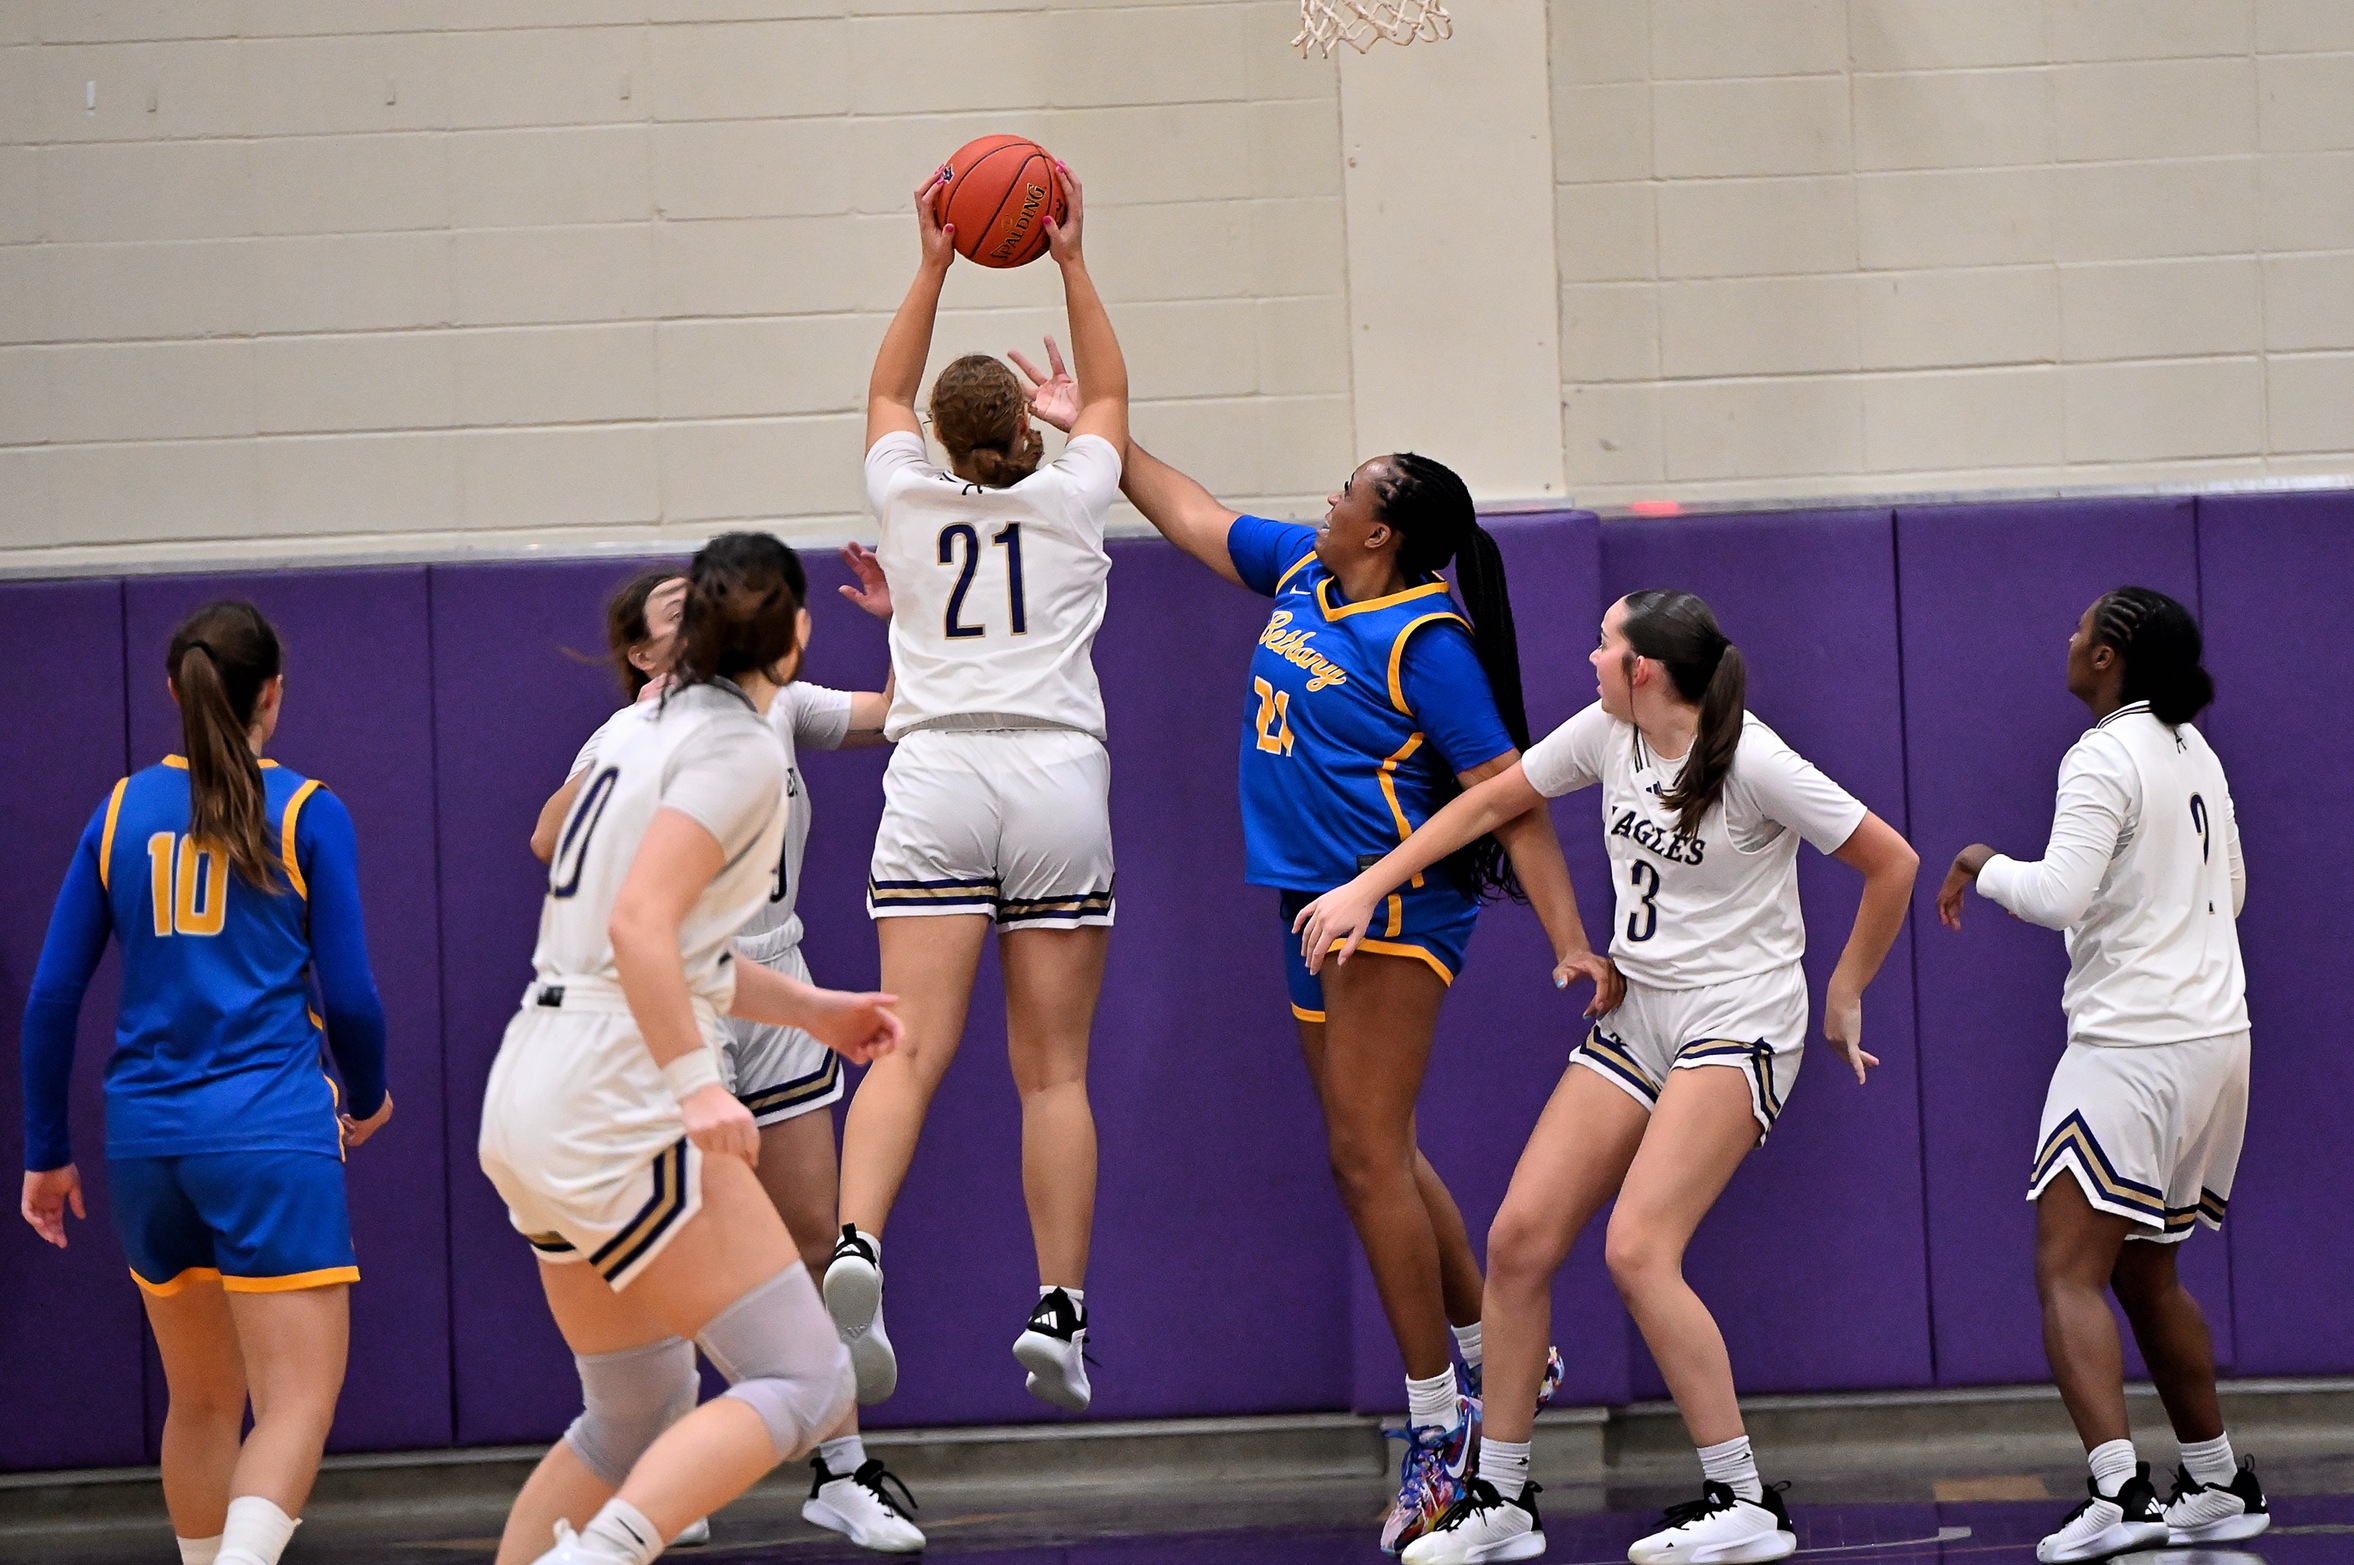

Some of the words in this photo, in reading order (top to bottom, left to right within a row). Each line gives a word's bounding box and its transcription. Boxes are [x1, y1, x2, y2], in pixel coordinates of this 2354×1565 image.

[990, 182, 1047, 262] SPALDING
[936, 521, 1028, 641] 21
[1259, 610, 1347, 692] Bethany
[1254, 675, 1295, 757] 21
[1611, 805, 1706, 866] AGLES
[147, 831, 230, 938] 10
[1626, 857, 1660, 943] 3
